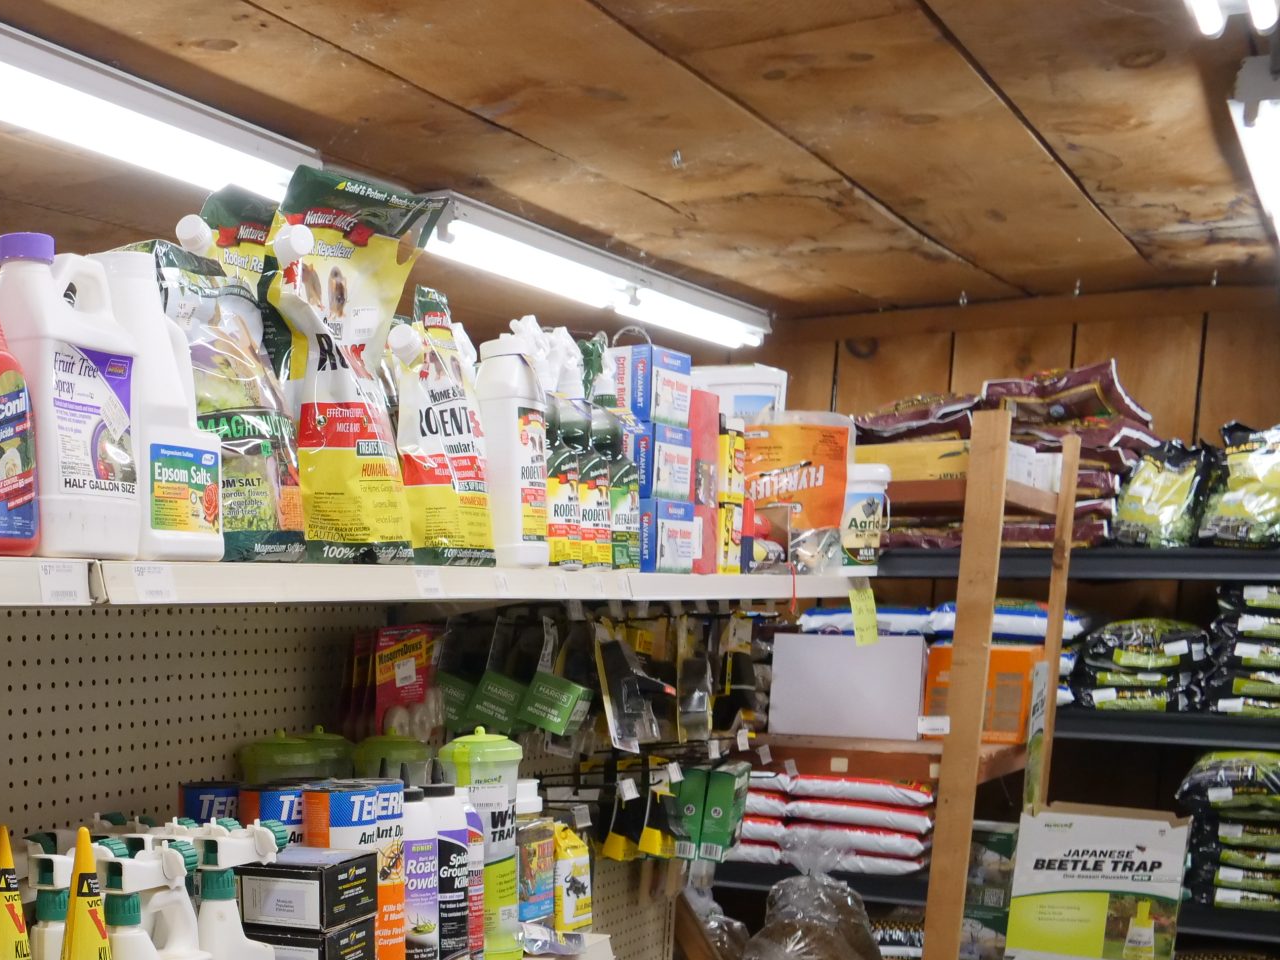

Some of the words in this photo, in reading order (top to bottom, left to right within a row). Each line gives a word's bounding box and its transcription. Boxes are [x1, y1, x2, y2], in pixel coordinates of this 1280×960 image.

[54, 351, 76, 375] Fruit
[78, 358, 99, 379] Tree
[637, 359, 646, 408] HAVAHART
[359, 441, 378, 454] TREATS
[638, 437, 647, 488] HAVAHART
[155, 462, 188, 483] Epsom
[191, 466, 211, 485] Salts
[64, 478, 86, 489] HALF
[89, 479, 120, 492] GALLON
[121, 482, 136, 494] SIZE
[239, 478, 262, 487] SALT
[308, 530, 347, 542] CAUTION
[641, 512, 650, 560] HAVAHART
[322, 546, 355, 558] 100%
[539, 685, 568, 702] HARRIS
[1064, 850, 1134, 859] JAPANESE
[1033, 859, 1104, 872] BEETLE
[1112, 861, 1162, 873] TRAP
